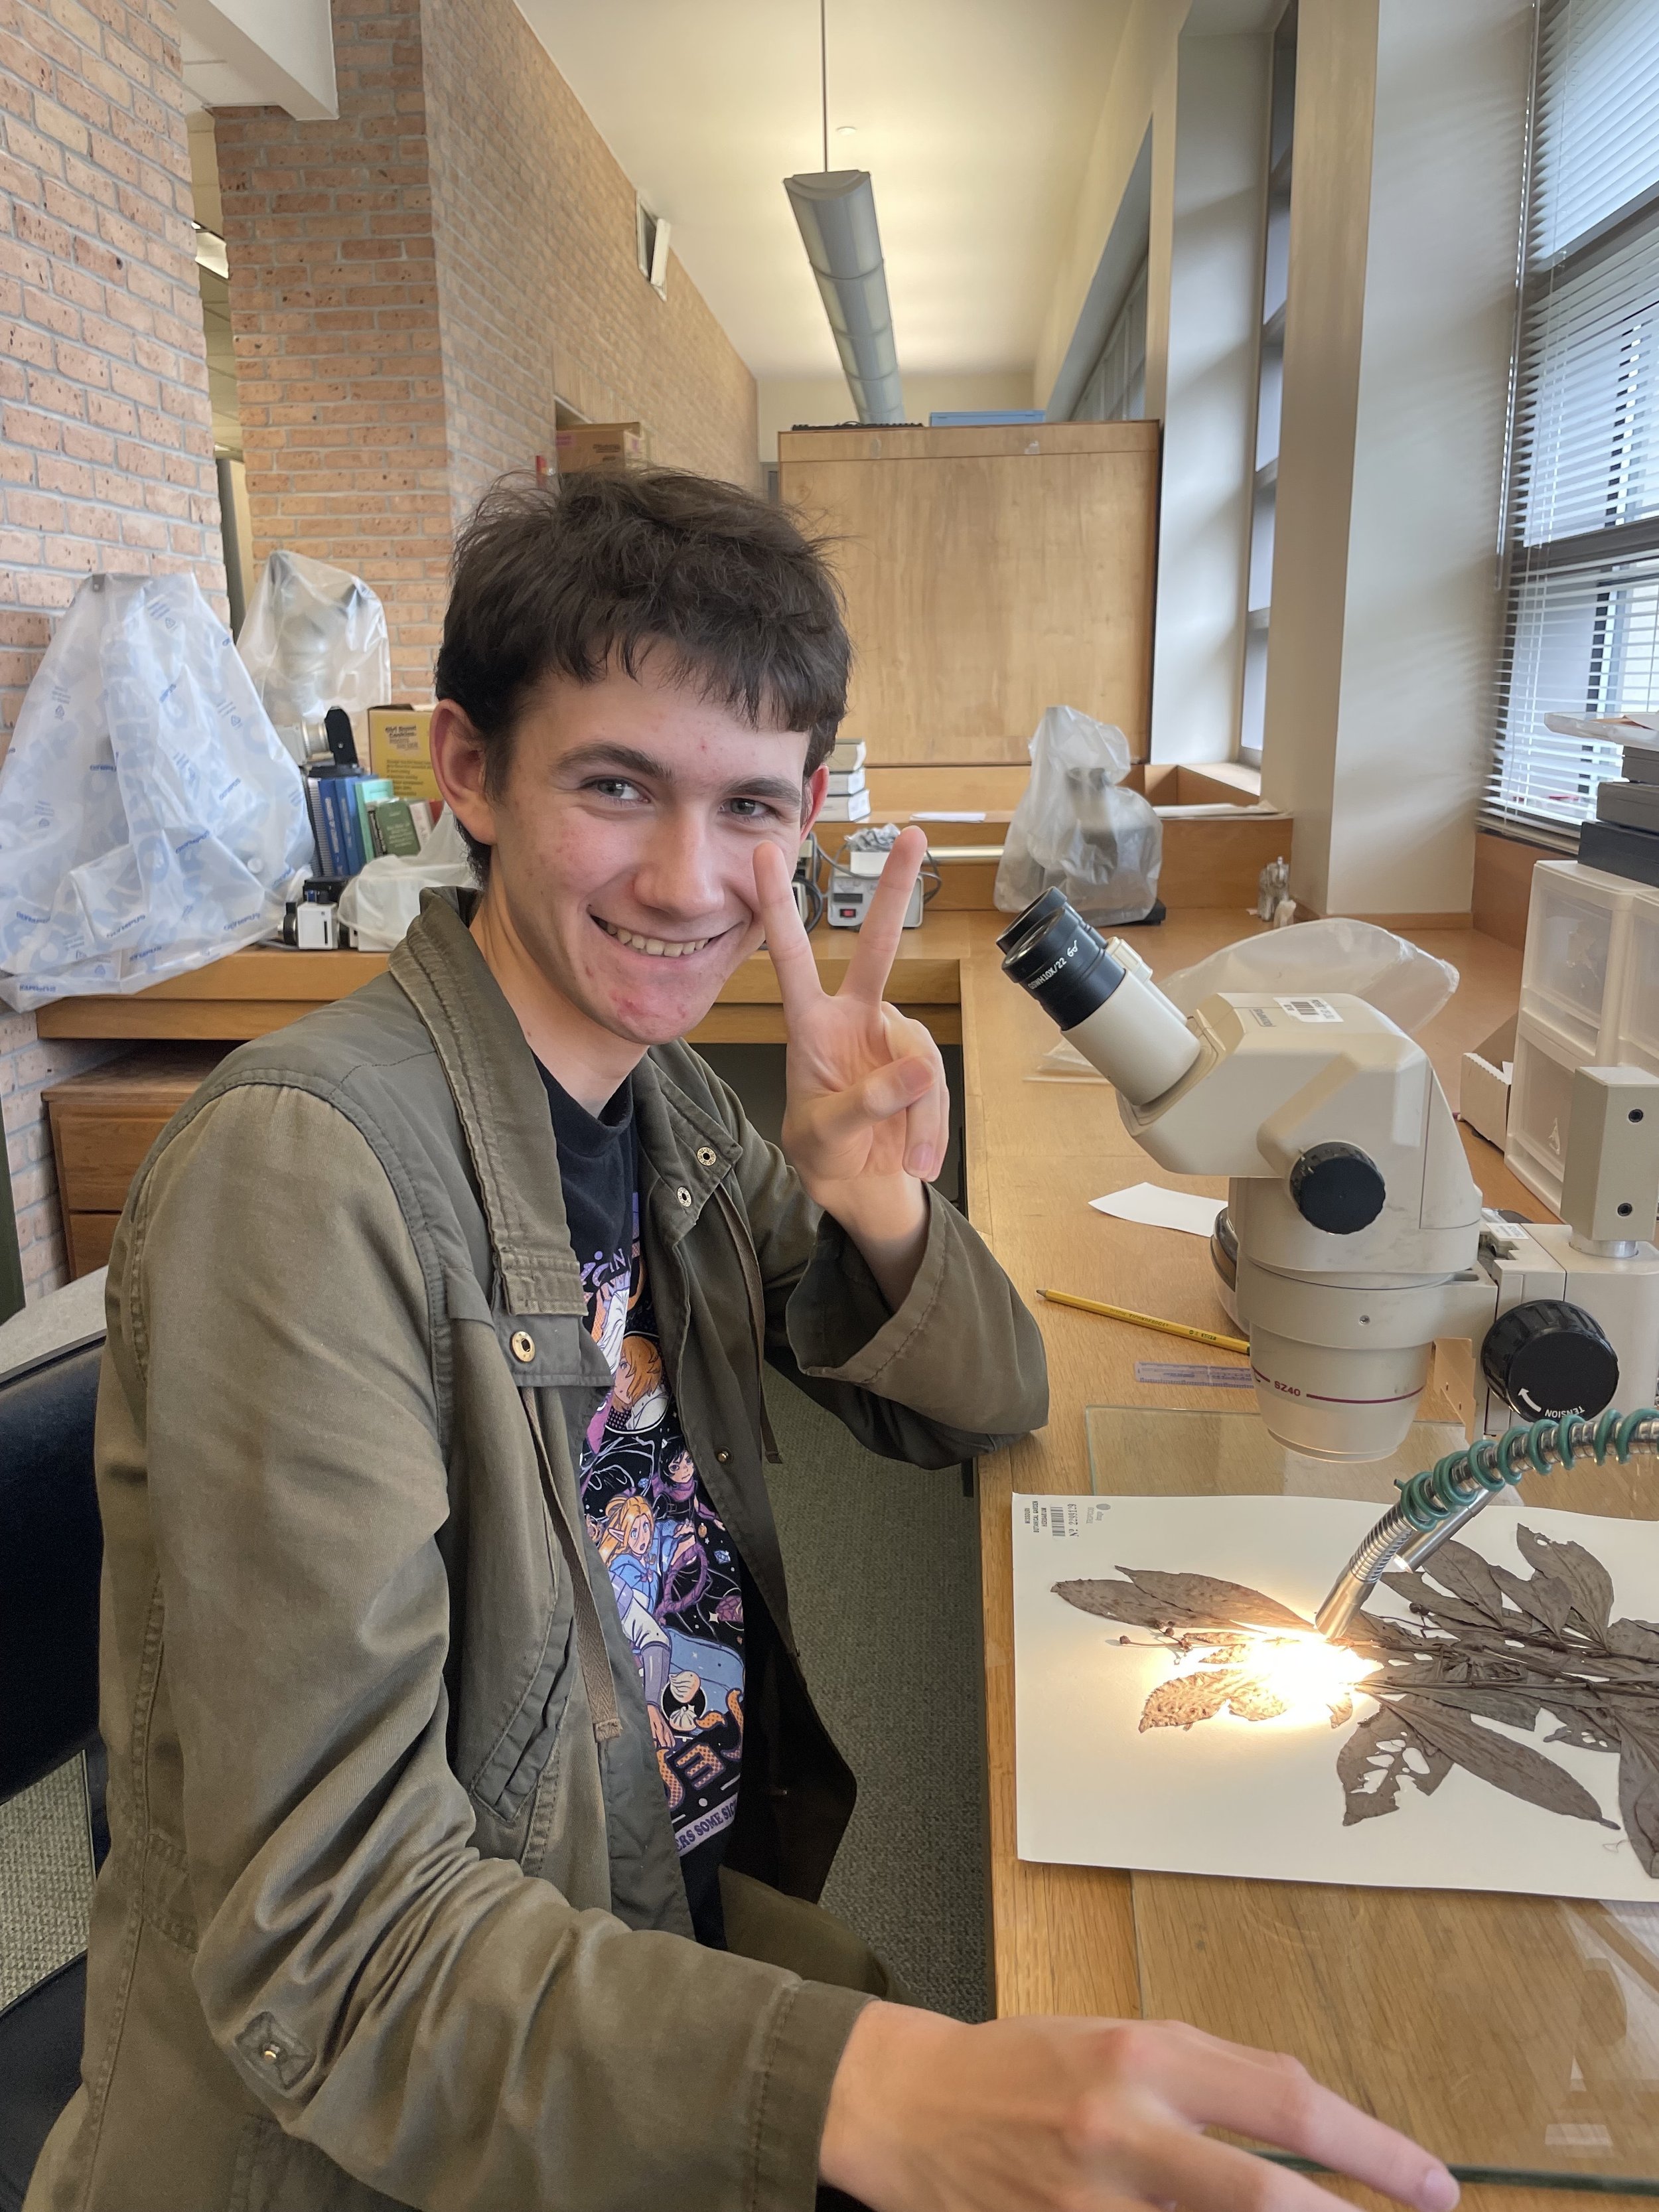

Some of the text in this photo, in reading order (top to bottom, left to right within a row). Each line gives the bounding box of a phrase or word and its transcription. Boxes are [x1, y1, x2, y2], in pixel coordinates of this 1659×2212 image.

[1274, 1380, 1301, 1396] SZ40
[1545, 1406, 1585, 1418] TENSION
[693, 1812, 724, 1836] SOME
